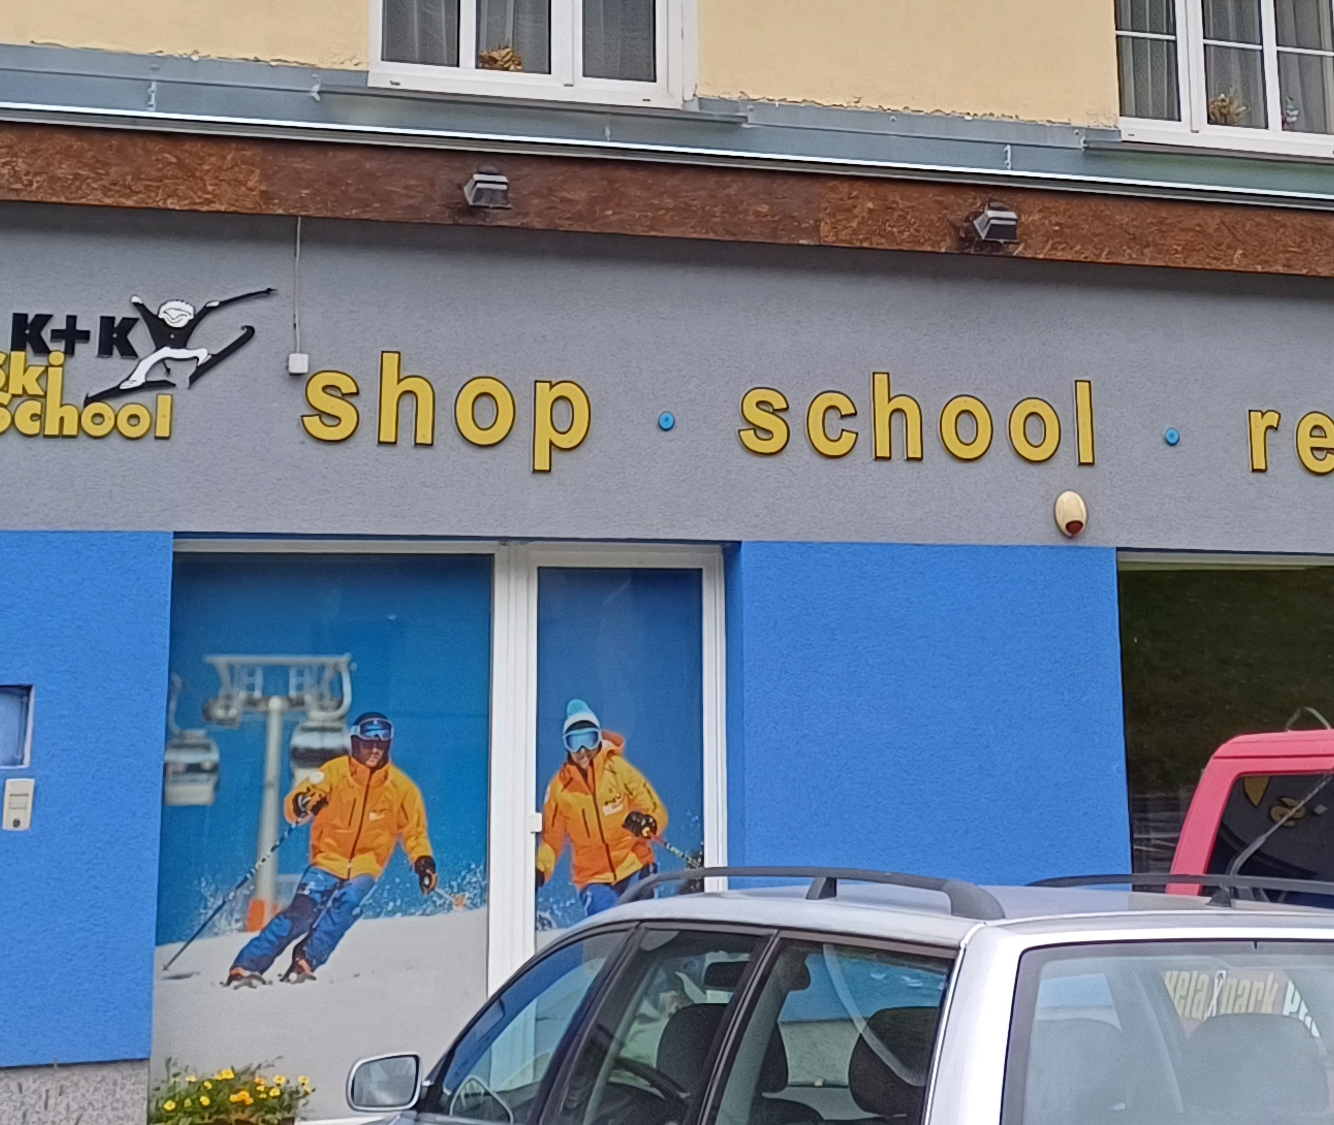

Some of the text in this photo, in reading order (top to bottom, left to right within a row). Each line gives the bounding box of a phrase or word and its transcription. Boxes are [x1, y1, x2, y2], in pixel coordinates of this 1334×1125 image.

[10, 312, 140, 359] K+K
[300, 350, 592, 473] shop
[737, 371, 1096, 467] school
